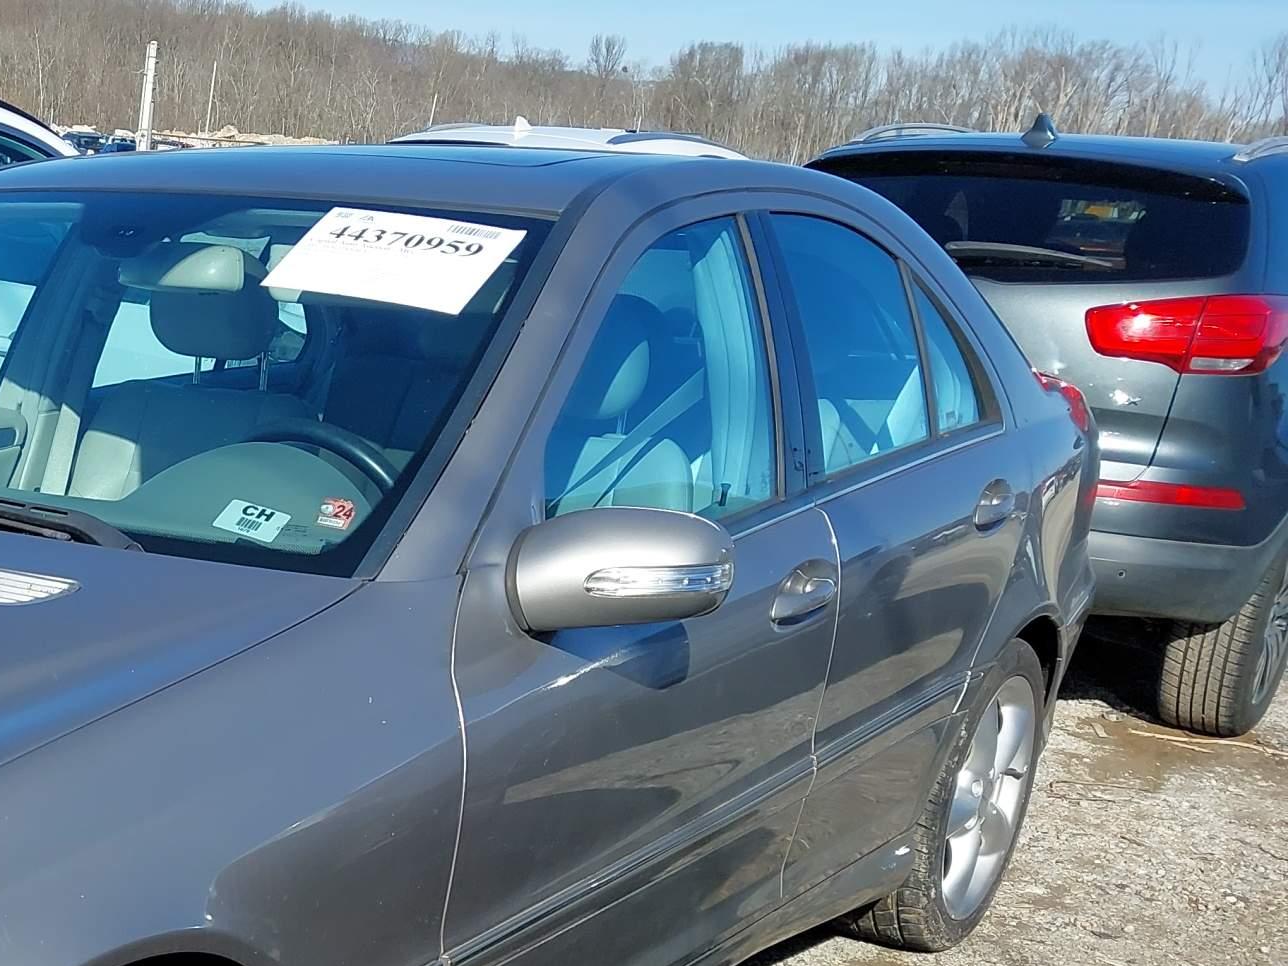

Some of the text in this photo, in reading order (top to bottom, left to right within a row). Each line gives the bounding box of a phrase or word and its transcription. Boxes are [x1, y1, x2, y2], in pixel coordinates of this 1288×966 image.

[329, 225, 484, 257] 44370959
[242, 505, 276, 522] CH
[333, 504, 354, 520] 24
